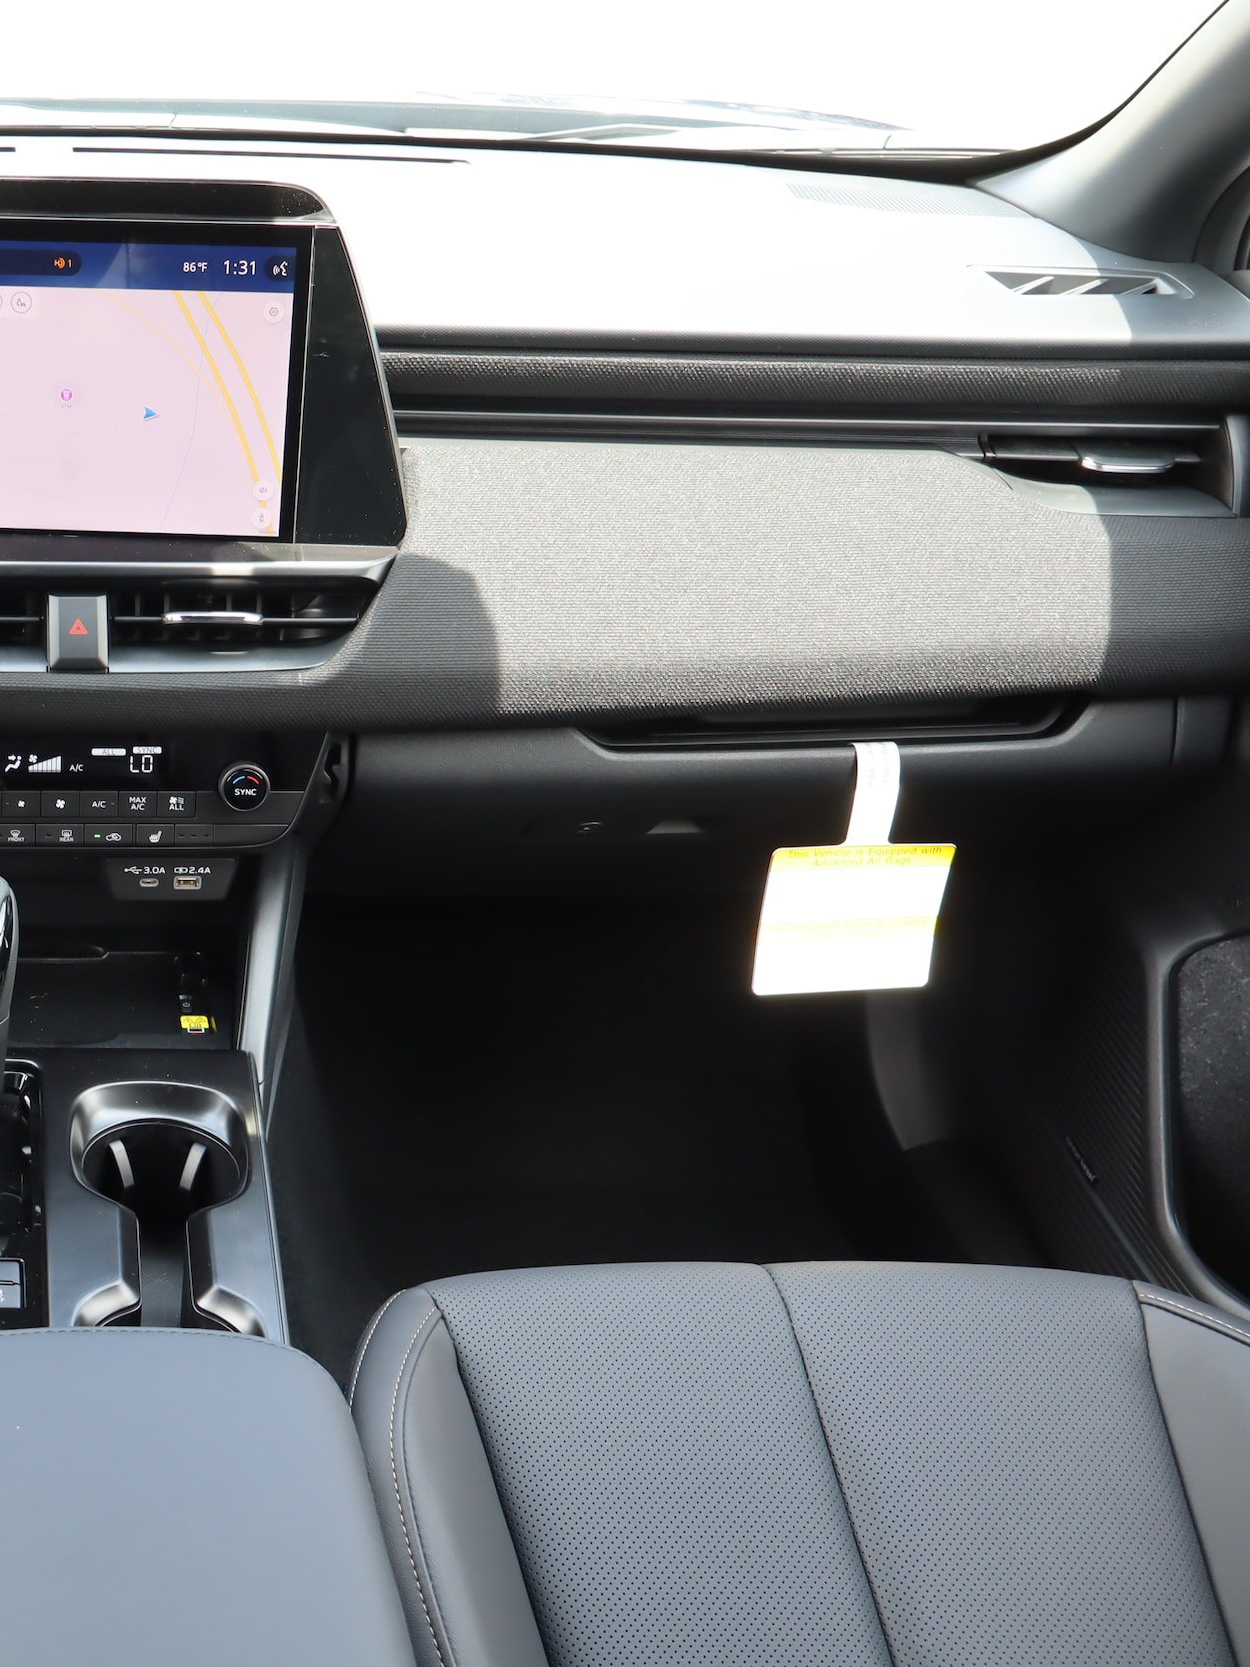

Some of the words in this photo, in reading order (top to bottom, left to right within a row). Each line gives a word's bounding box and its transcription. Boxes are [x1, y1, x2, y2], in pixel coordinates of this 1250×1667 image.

[223, 260, 256, 275] 1:31
[69, 763, 84, 773] A/C
[129, 755, 154, 773] LO
[234, 788, 257, 796] SYNC
[91, 800, 107, 809] A/C
[128, 796, 147, 804] MAX
[130, 803, 146, 811] A/C
[168, 803, 185, 811] ALL
[788, 850, 809, 859] This
[814, 848, 851, 858] Vehicle
[868, 846, 918, 857] Equipped
[921, 846, 943, 855] with
[812, 858, 863, 867] Advanced
[885, 857, 912, 867] Bags
[143, 866, 166, 875] 3.0A
[188, 866, 211, 875] 2.4A
